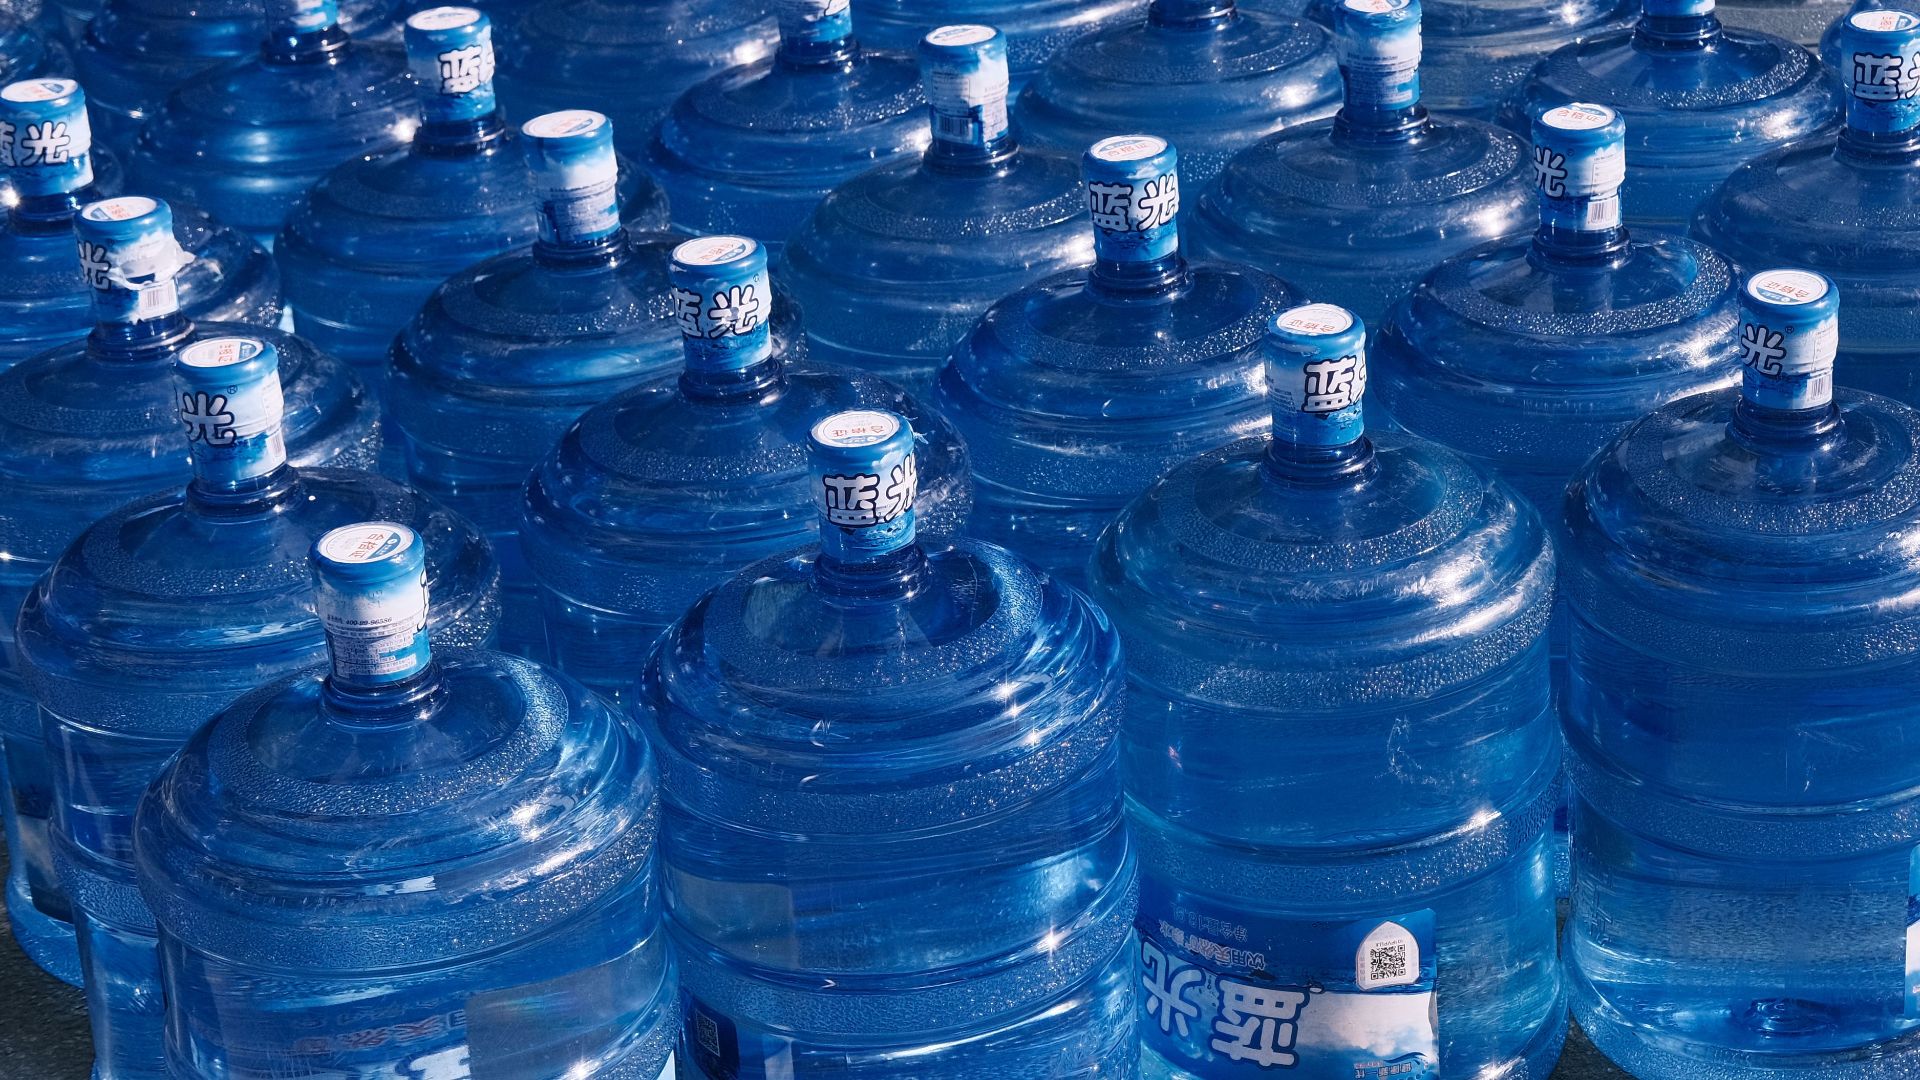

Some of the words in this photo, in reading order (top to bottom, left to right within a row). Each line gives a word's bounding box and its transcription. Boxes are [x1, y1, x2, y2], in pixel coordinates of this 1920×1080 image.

[437, 45, 495, 95] 蓝
[1089, 173, 1177, 232] 蓝光
[822, 452, 917, 529] 蓝光
[1141, 938, 1310, 1068] 蓝光
